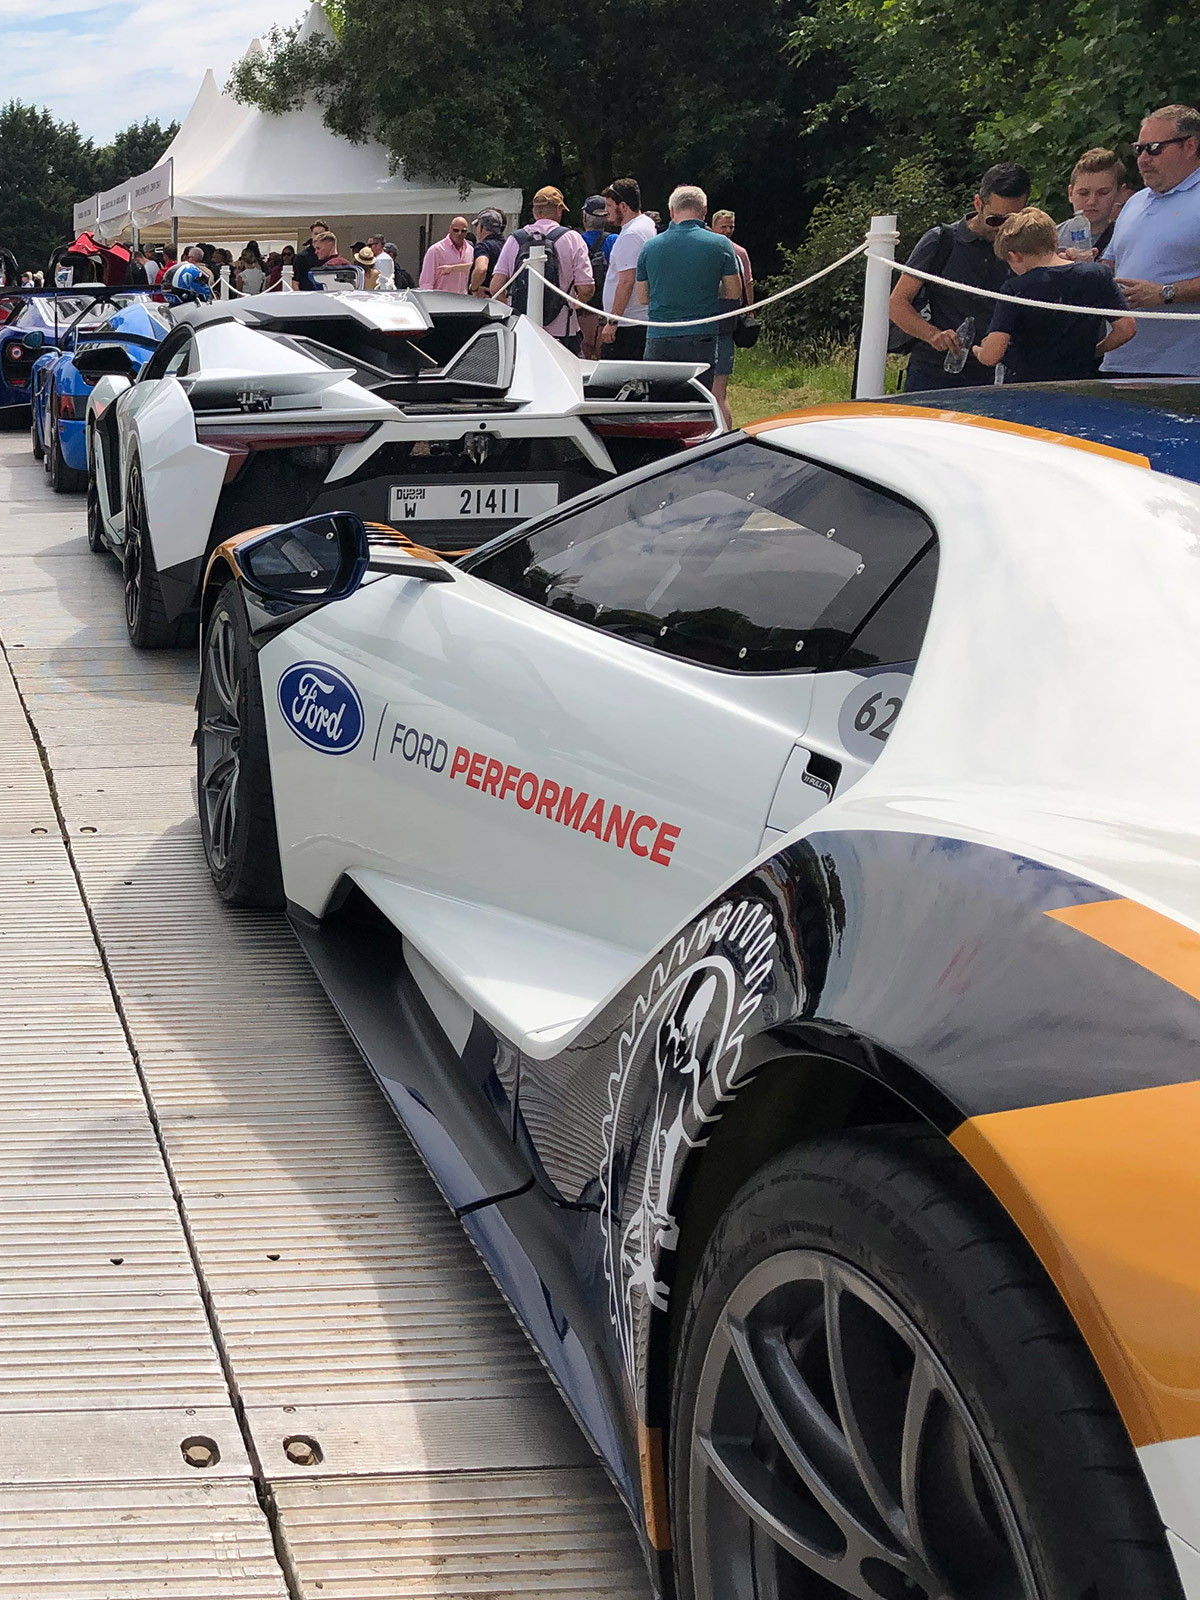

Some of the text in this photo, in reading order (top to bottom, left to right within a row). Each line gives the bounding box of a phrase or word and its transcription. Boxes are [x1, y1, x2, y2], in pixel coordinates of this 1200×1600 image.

[404, 502, 417, 519] W
[459, 488, 520, 515] 21411
[291, 672, 346, 742] Ford
[390, 722, 682, 867] FORD PERFORMANCE
